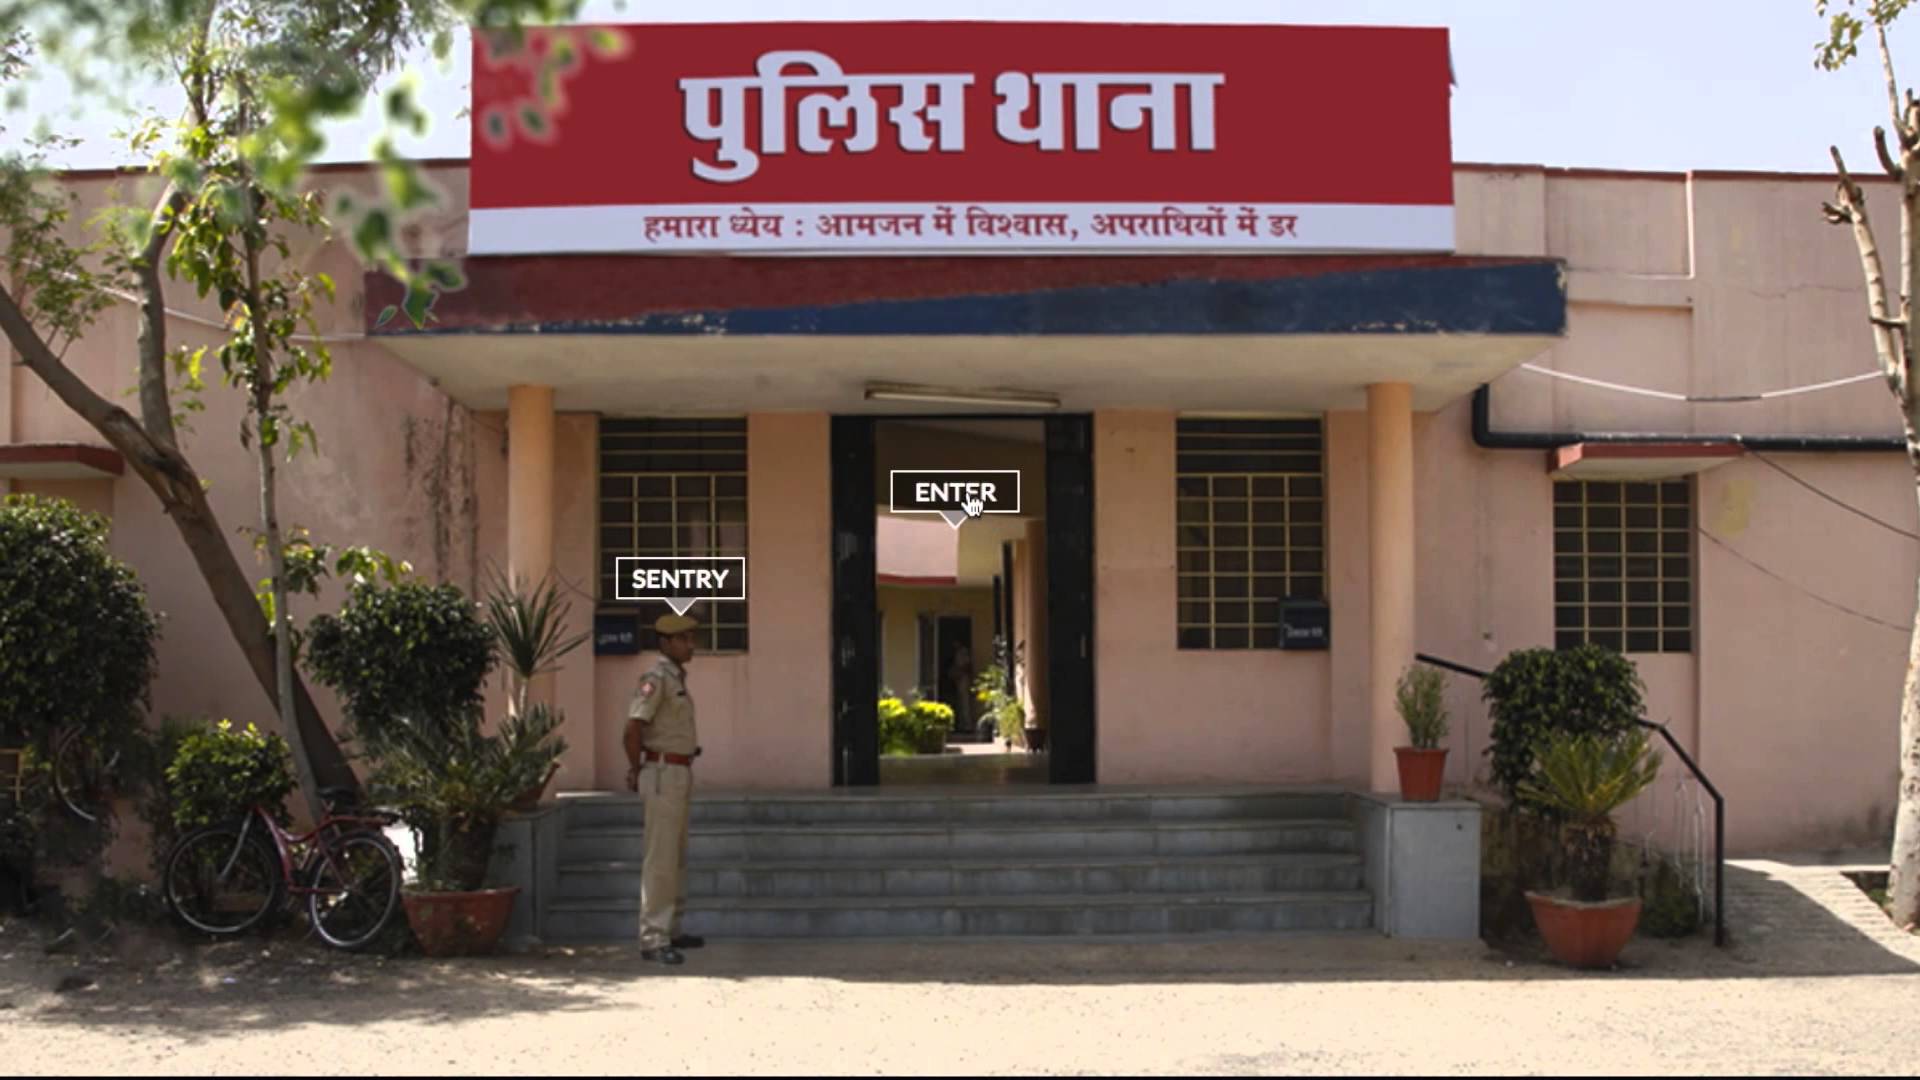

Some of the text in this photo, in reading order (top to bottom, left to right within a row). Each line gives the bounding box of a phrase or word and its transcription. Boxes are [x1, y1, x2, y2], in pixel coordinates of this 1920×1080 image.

[679, 50, 1225, 183] पुलिस थाना
[644, 215, 721, 241] हमारा
[729, 207, 784, 237] ध्येय
[817, 213, 925, 236] आमजन
[933, 206, 957, 236] में
[966, 207, 1079, 240] विश्वास,
[1091, 207, 1227, 237] अपराधियों
[1236, 207, 1259, 237] में
[1267, 214, 1298, 237] डर
